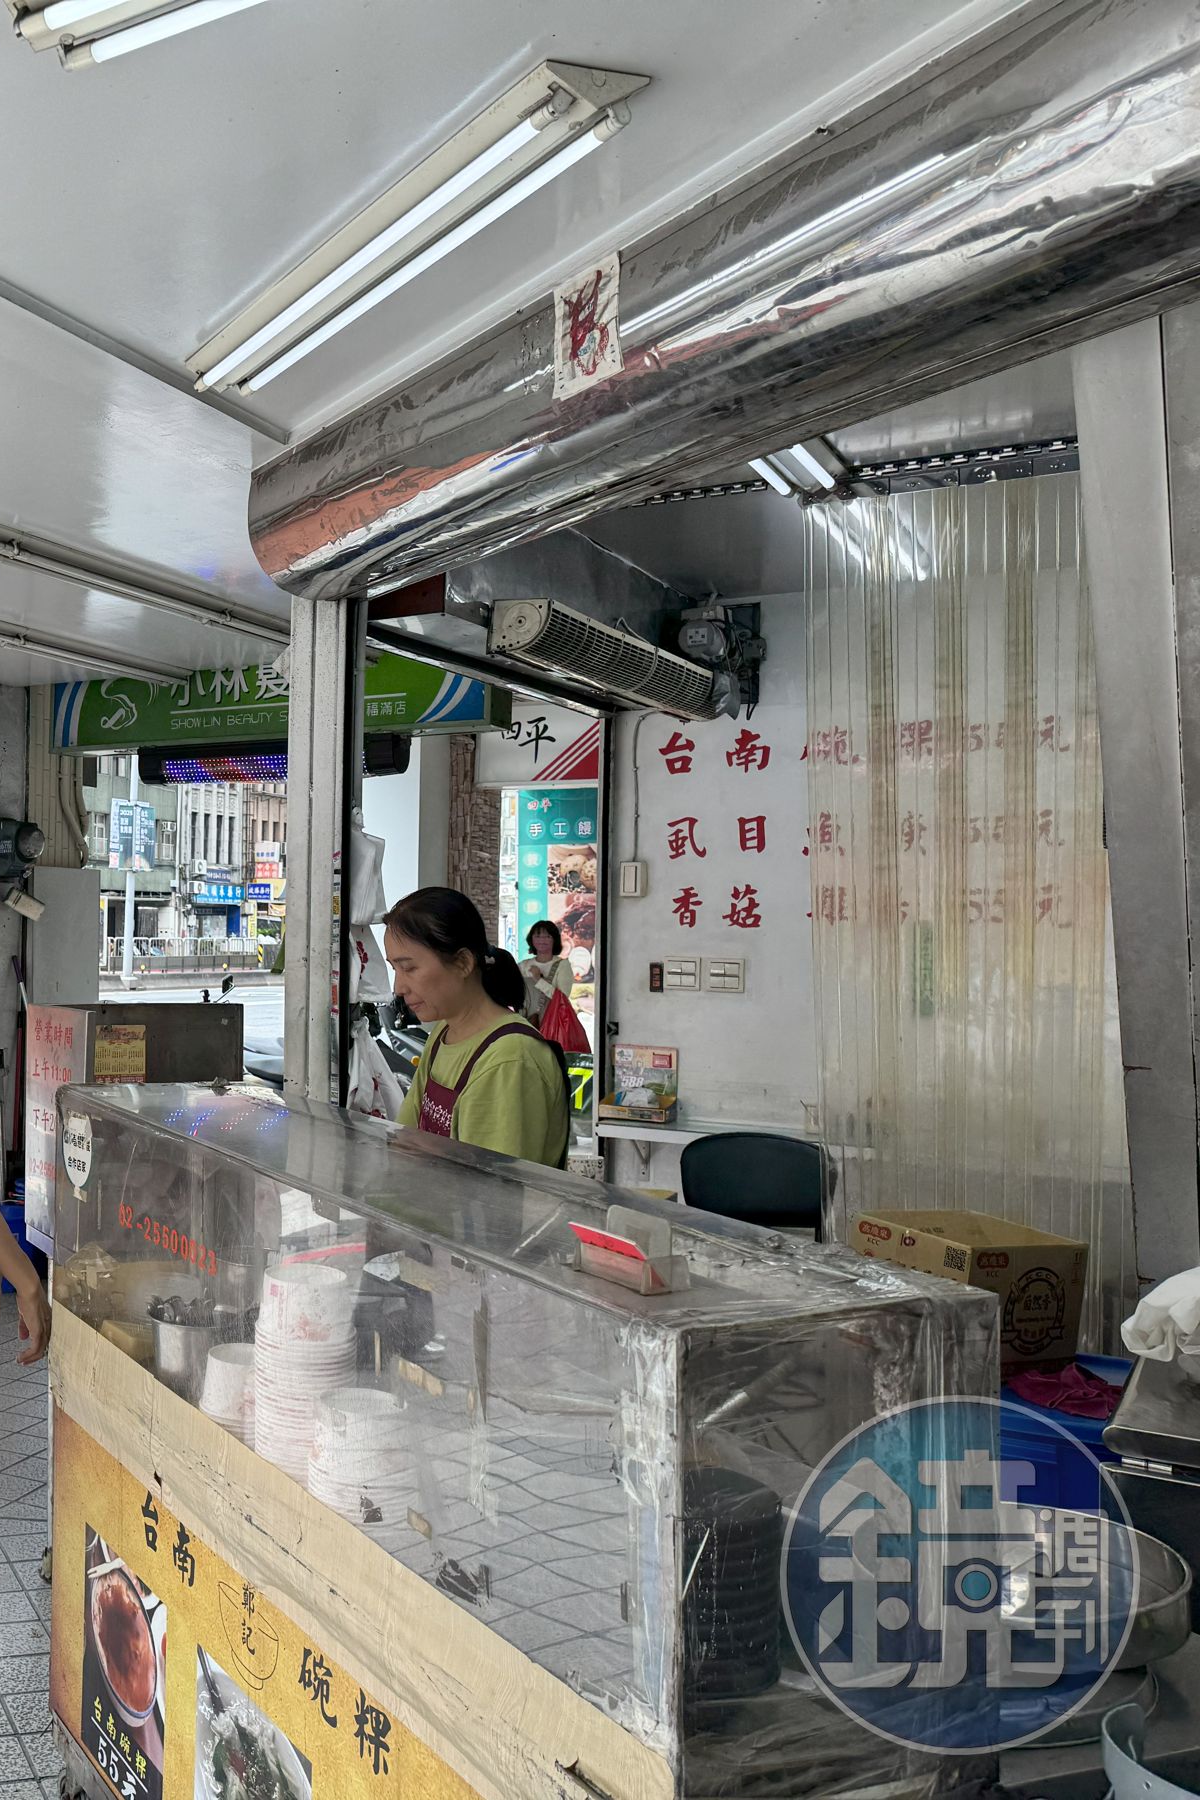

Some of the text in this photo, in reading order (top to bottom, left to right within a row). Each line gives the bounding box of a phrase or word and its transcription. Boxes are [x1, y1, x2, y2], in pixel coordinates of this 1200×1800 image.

[227, 712, 273, 726] BEAUTY
[366, 701, 407, 717] 福滿店
[501, 716, 556, 764] 四平
[528, 820, 592, 837] 手工饅
[34, 1017, 73, 1049] 營業時間
[141, 1490, 196, 1587] 台南
[298, 1646, 392, 1776] 碗粿
[94, 1695, 147, 1780] 台南碗粿
